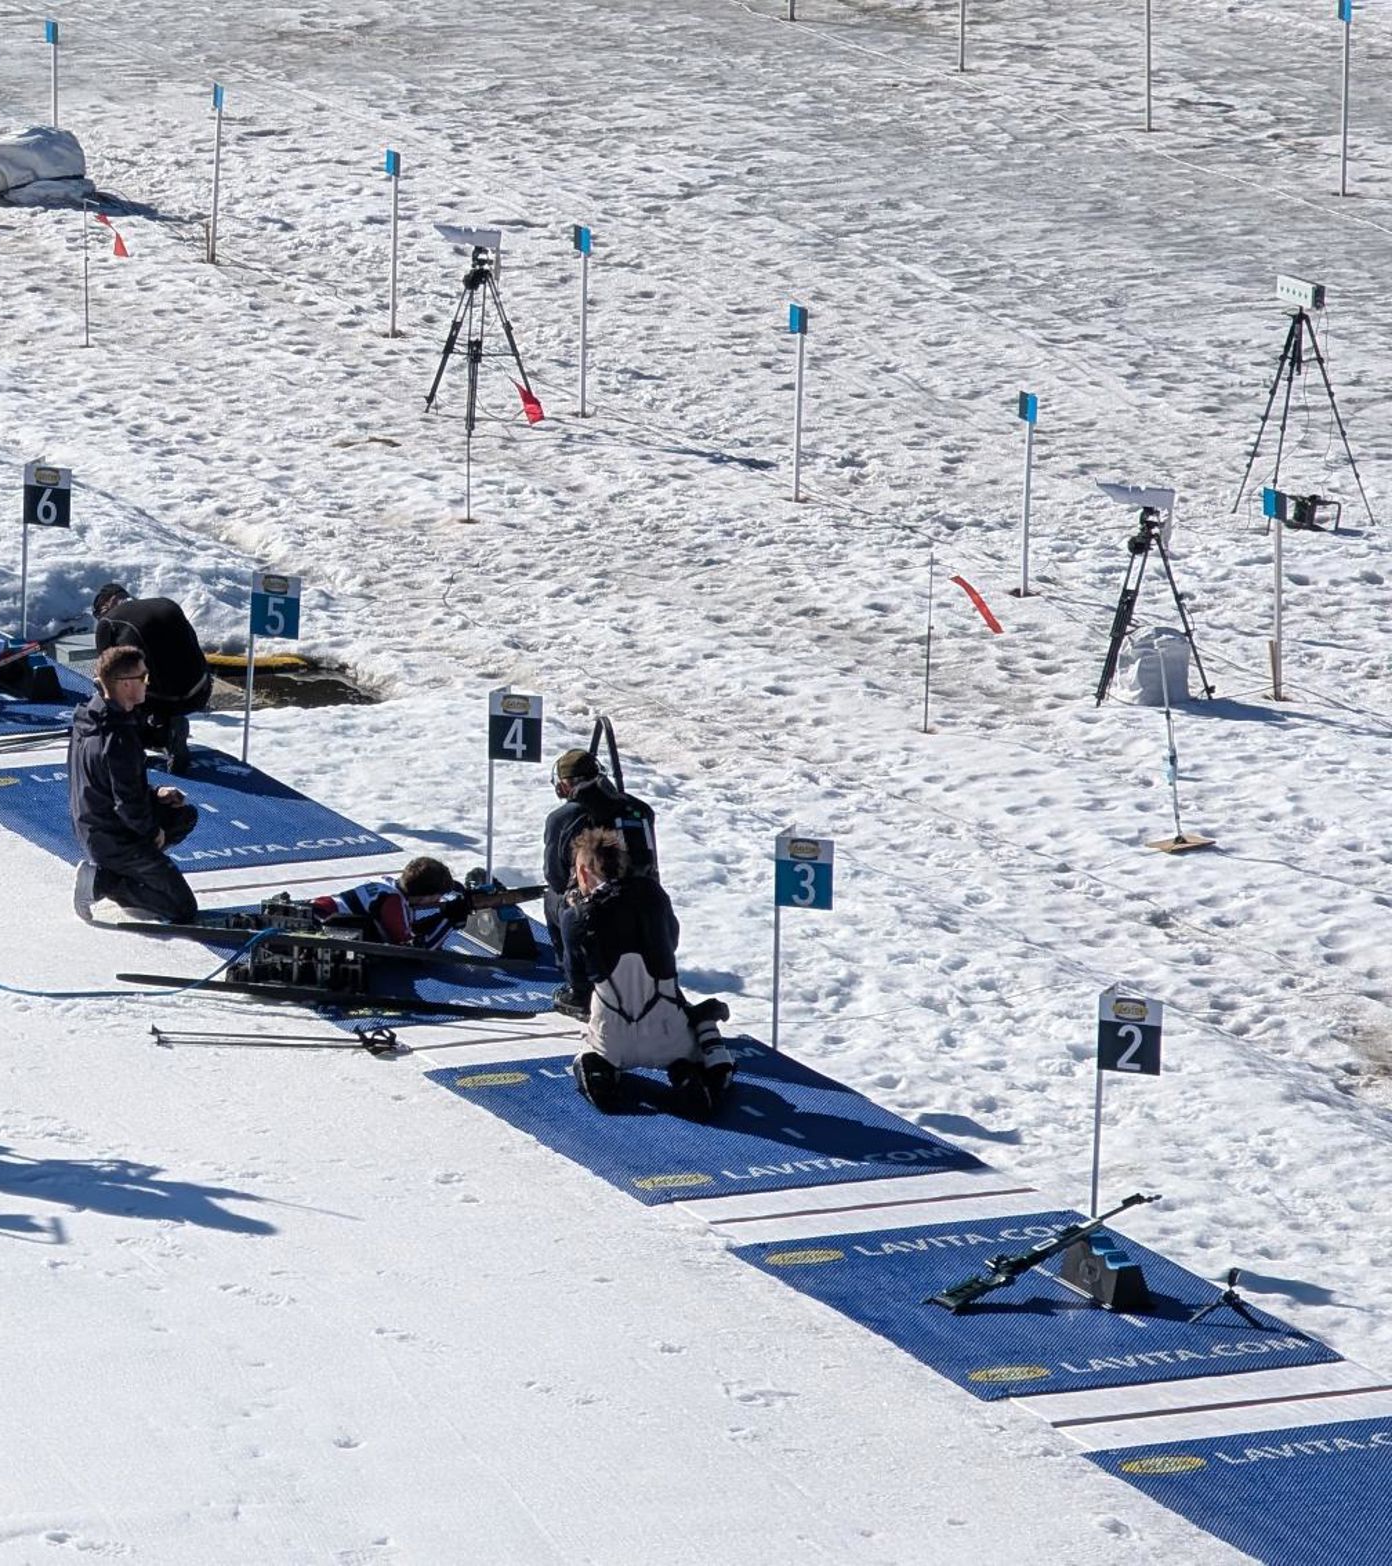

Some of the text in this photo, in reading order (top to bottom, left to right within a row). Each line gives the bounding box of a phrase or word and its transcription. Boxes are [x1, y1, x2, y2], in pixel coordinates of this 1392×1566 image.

[36, 488, 57, 524] 6
[265, 597, 285, 635] 5
[503, 718, 527, 759] 4
[169, 834, 378, 862] LAVITA.COM
[792, 862, 816, 906] 3
[1116, 1024, 1142, 1071] 2
[721, 1147, 955, 1180] LAVITA.COM
[1060, 1337, 1310, 1374] LAVITA.COM
